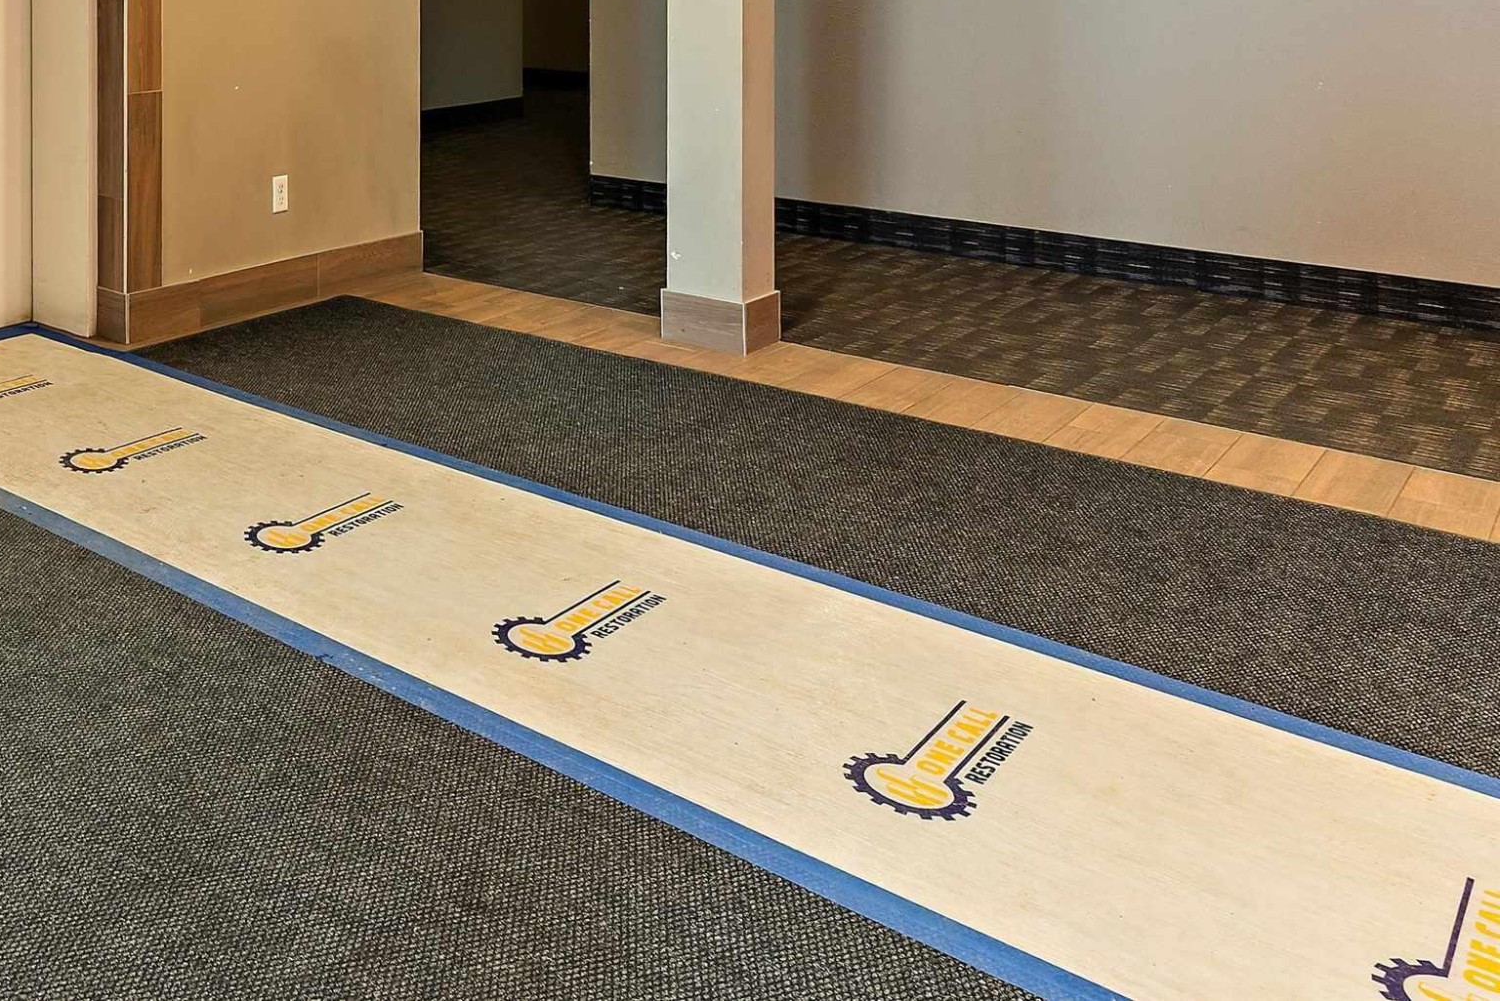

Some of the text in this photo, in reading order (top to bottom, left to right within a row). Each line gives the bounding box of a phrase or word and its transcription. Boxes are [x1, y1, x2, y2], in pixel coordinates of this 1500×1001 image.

[133, 435, 208, 461] RESTORATION
[328, 503, 404, 537] RESTORATION
[554, 584, 643, 632] ONE CALL
[590, 594, 668, 638] RESTORATION
[916, 707, 999, 776] ONE CALL
[964, 721, 1035, 785] RESTORATION
